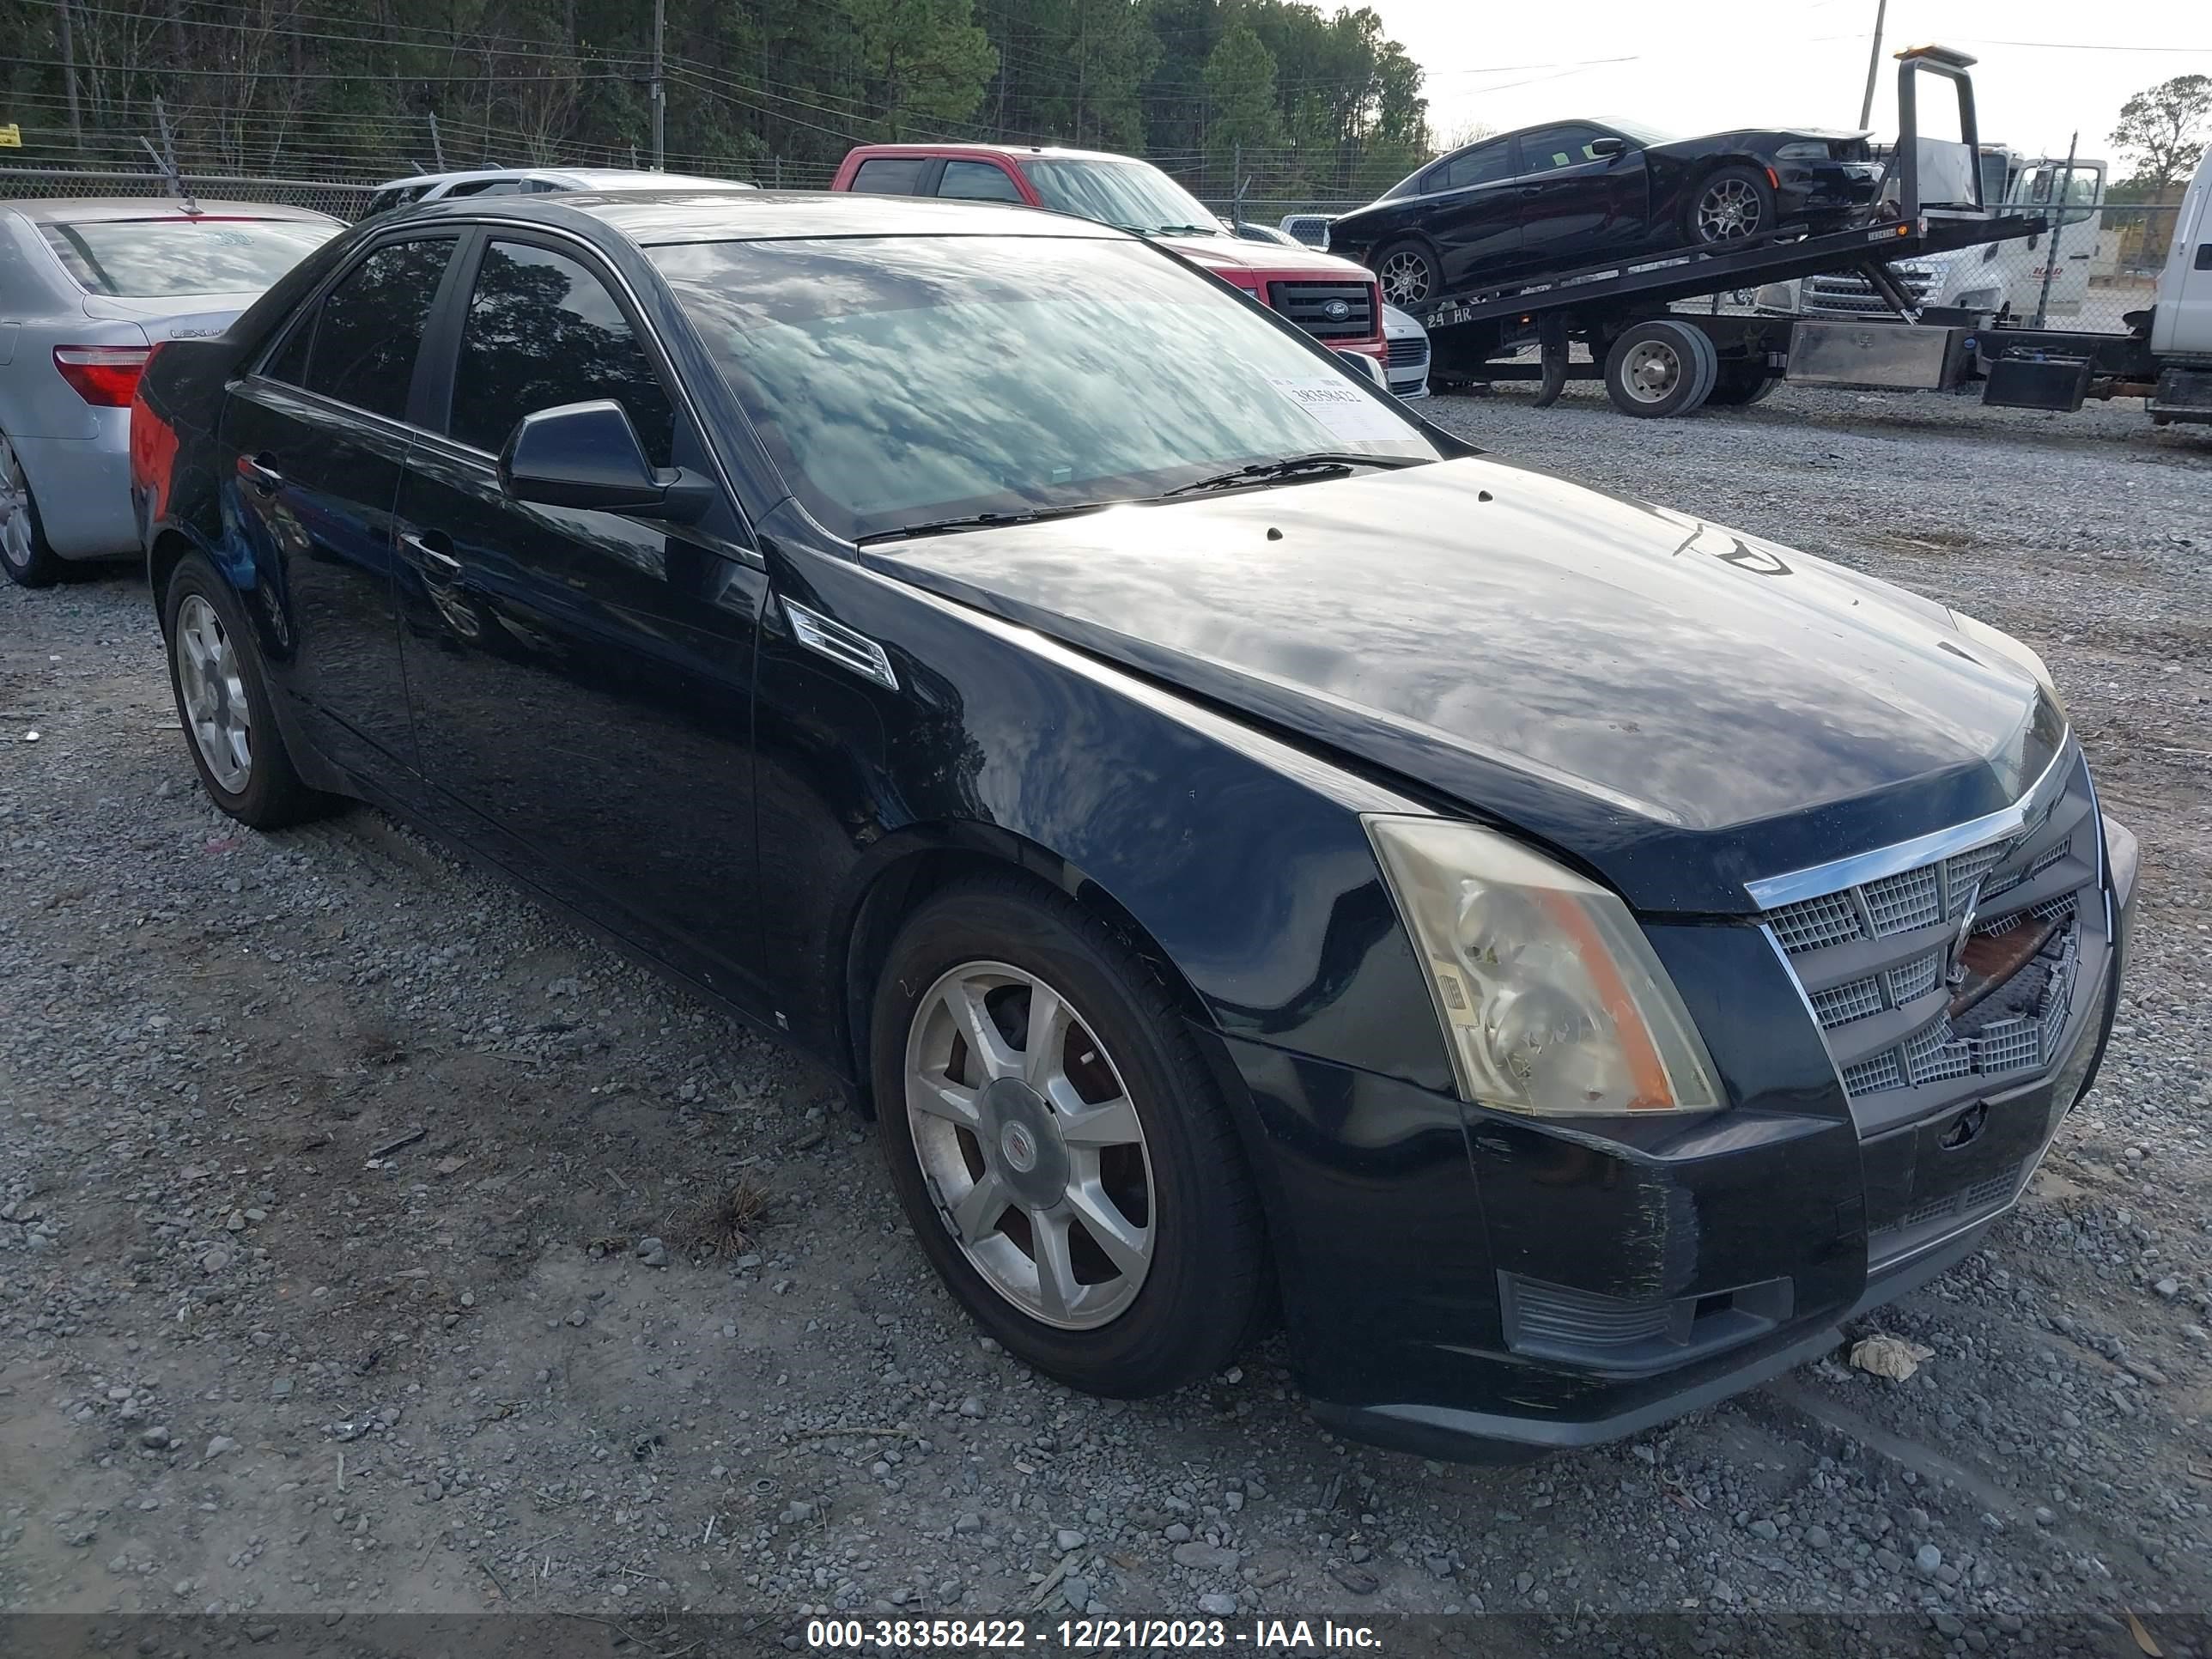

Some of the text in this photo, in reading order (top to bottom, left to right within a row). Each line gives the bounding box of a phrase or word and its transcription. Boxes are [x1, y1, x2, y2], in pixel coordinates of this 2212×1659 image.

[1427, 307, 1472, 328] 24 HR
[1291, 389, 1362, 403] 38358422
